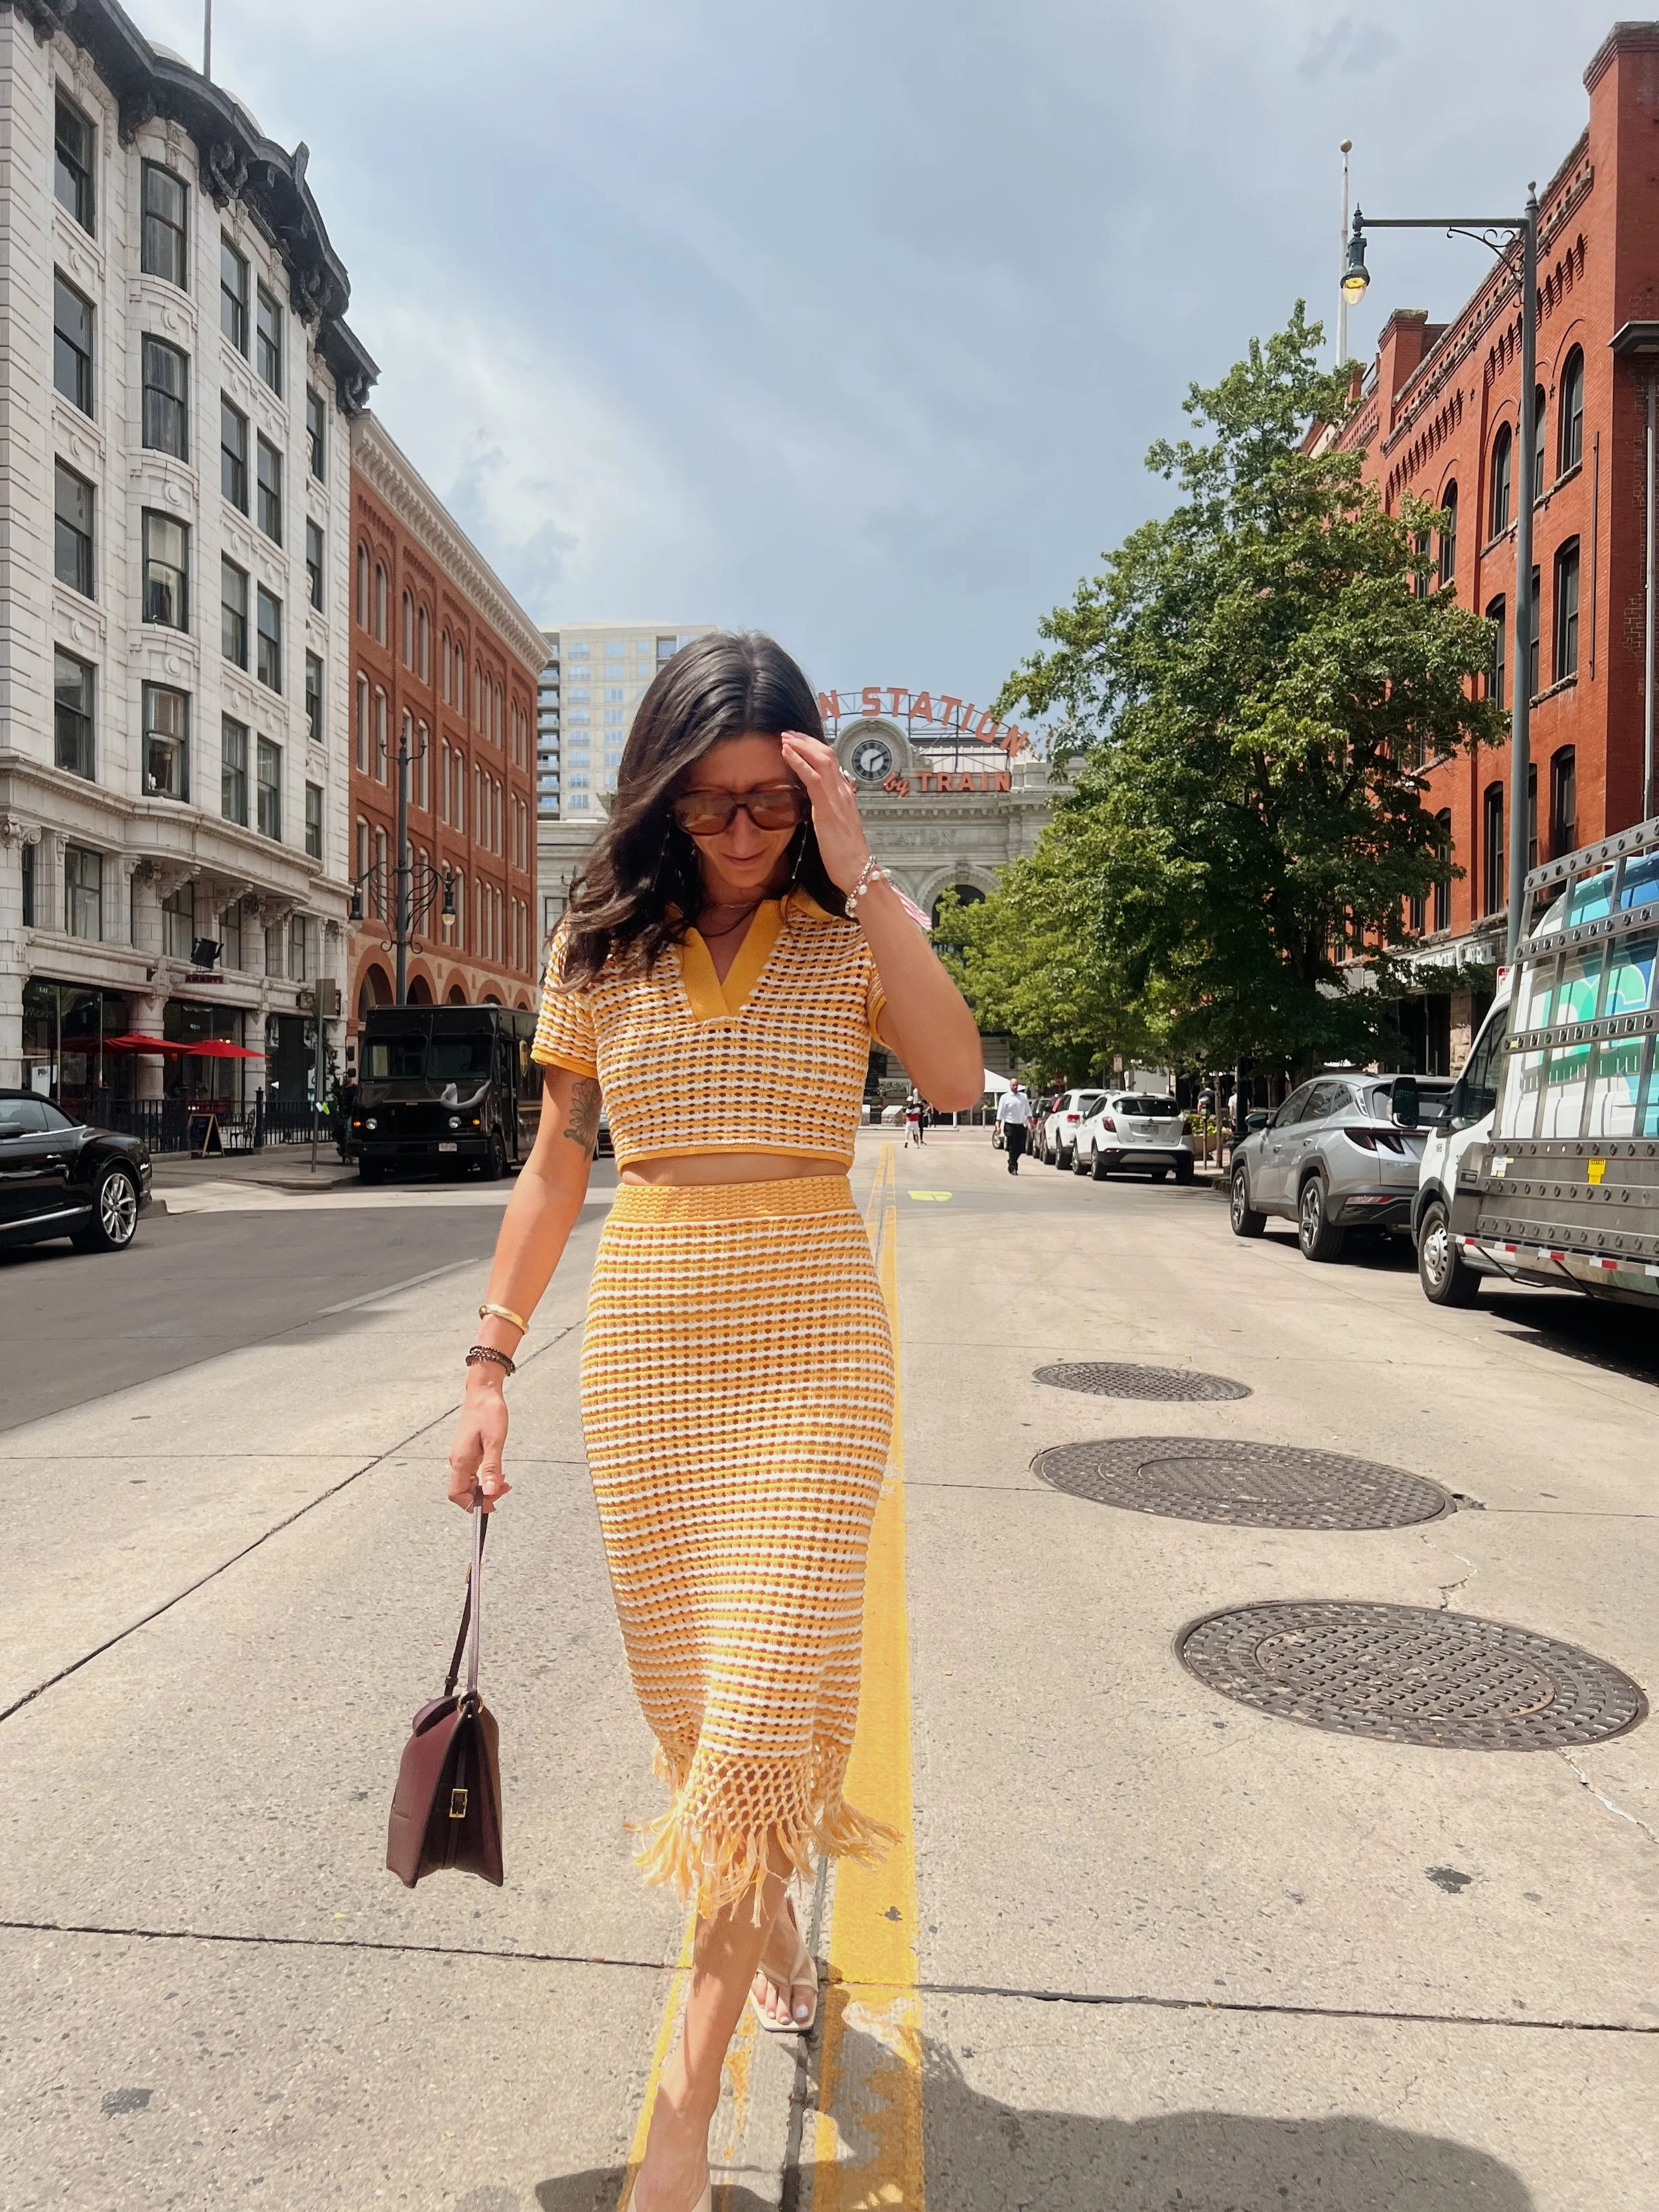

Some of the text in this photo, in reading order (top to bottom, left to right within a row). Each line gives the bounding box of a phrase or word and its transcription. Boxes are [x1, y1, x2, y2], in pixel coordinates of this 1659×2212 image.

[862, 687, 1029, 757] STATION
[883, 772, 910, 798] by
[917, 772, 1011, 792] TRAIN
[873, 829, 957, 846] STATION
